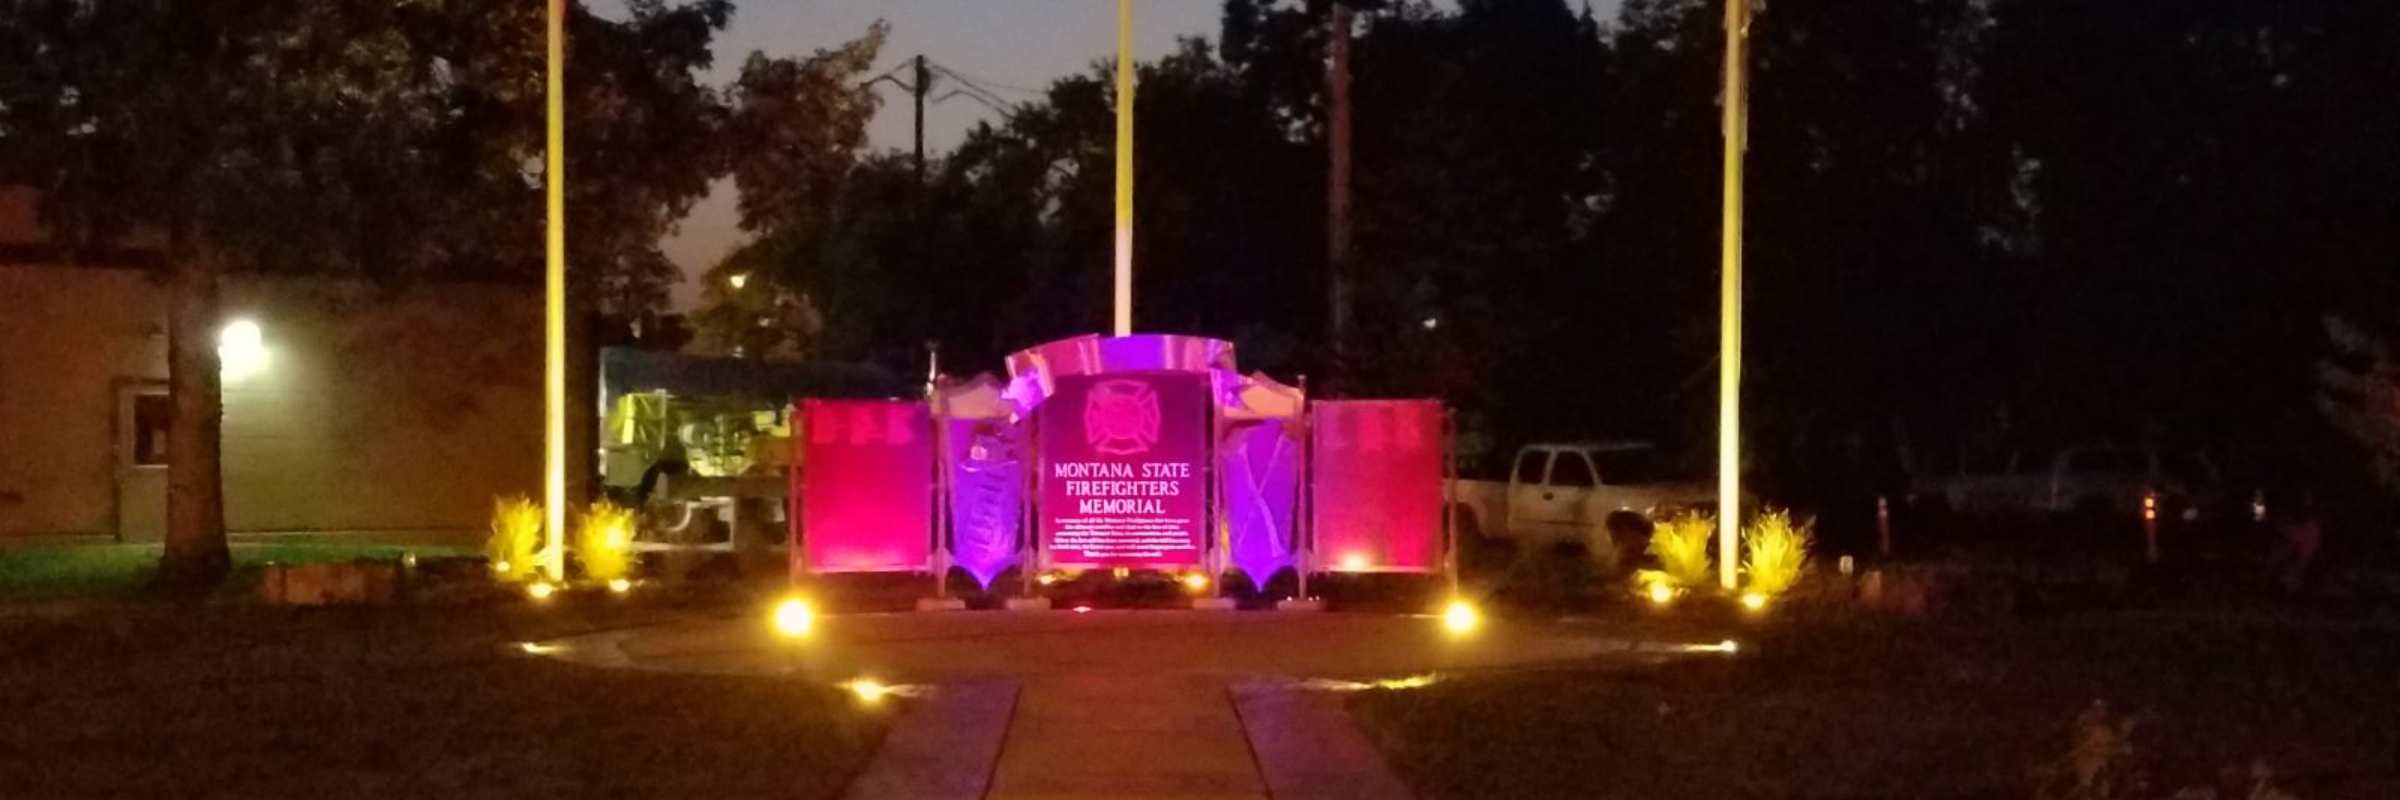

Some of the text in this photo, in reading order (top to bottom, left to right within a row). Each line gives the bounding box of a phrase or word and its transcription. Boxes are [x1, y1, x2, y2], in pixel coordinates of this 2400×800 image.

[1055, 462, 1190, 478] MONTANA STATE
[1066, 480, 1179, 496] FIREFIGHTERS
[1080, 498, 1166, 514] MEMORIAL
